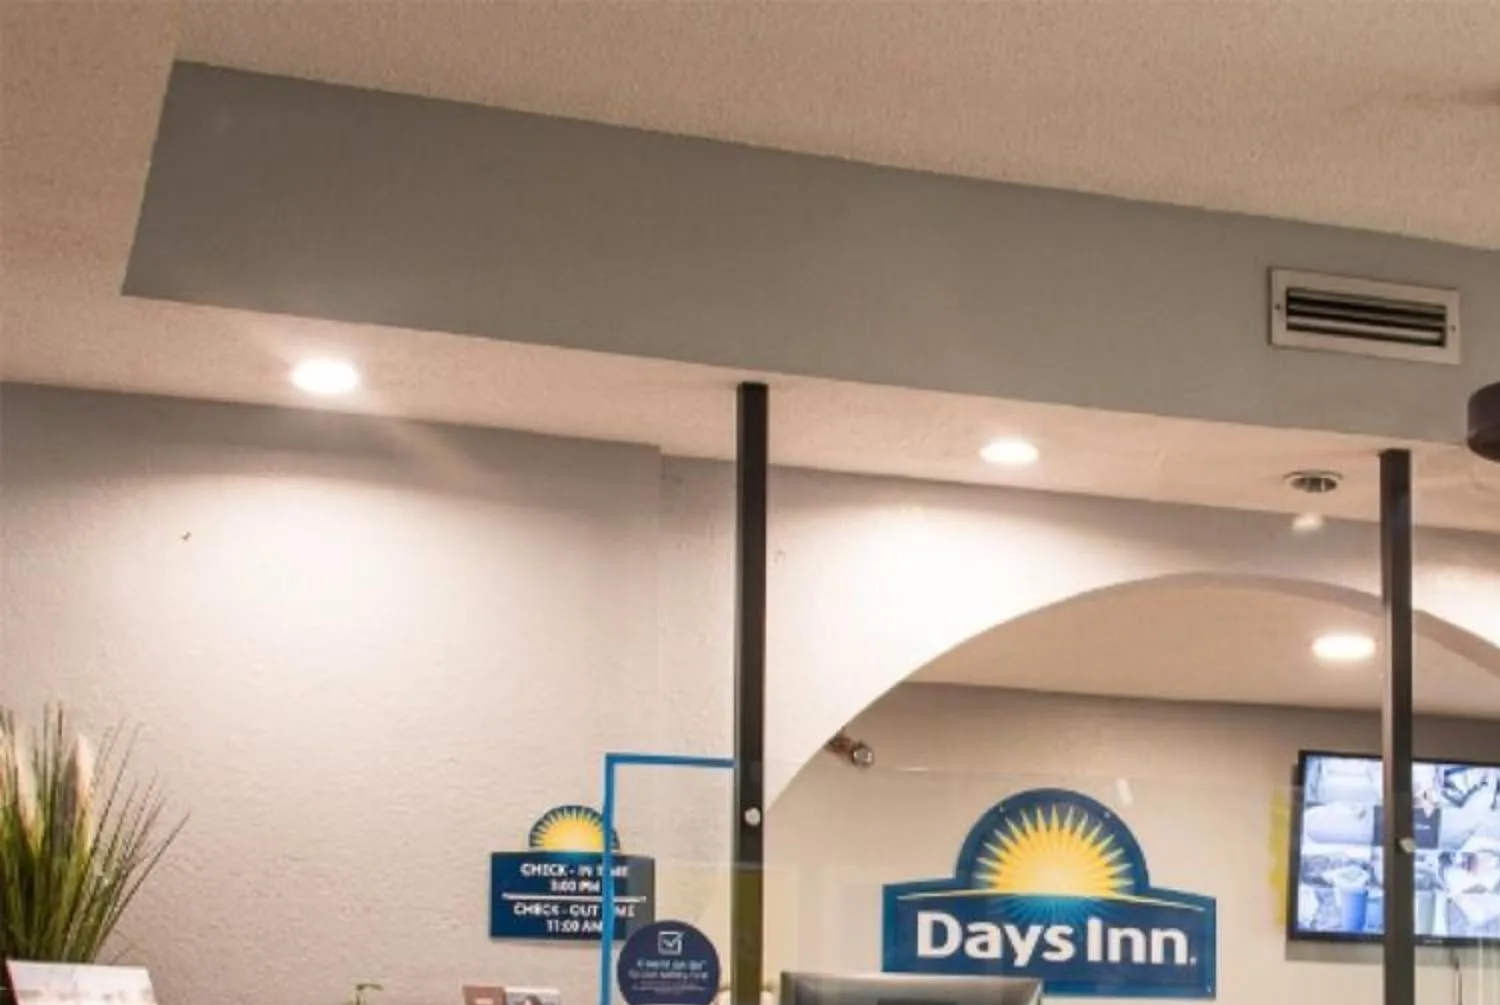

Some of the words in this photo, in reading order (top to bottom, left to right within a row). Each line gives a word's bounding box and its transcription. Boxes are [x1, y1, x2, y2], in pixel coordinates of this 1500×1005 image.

[520, 863, 568, 877] CHECK
[596, 865, 628, 877] TME
[513, 902, 560, 916] CHECK
[569, 903, 599, 917] OUT
[546, 920, 580, 932] 11:00
[916, 911, 1076, 967] Days
[1087, 916, 1189, 965] Inn
